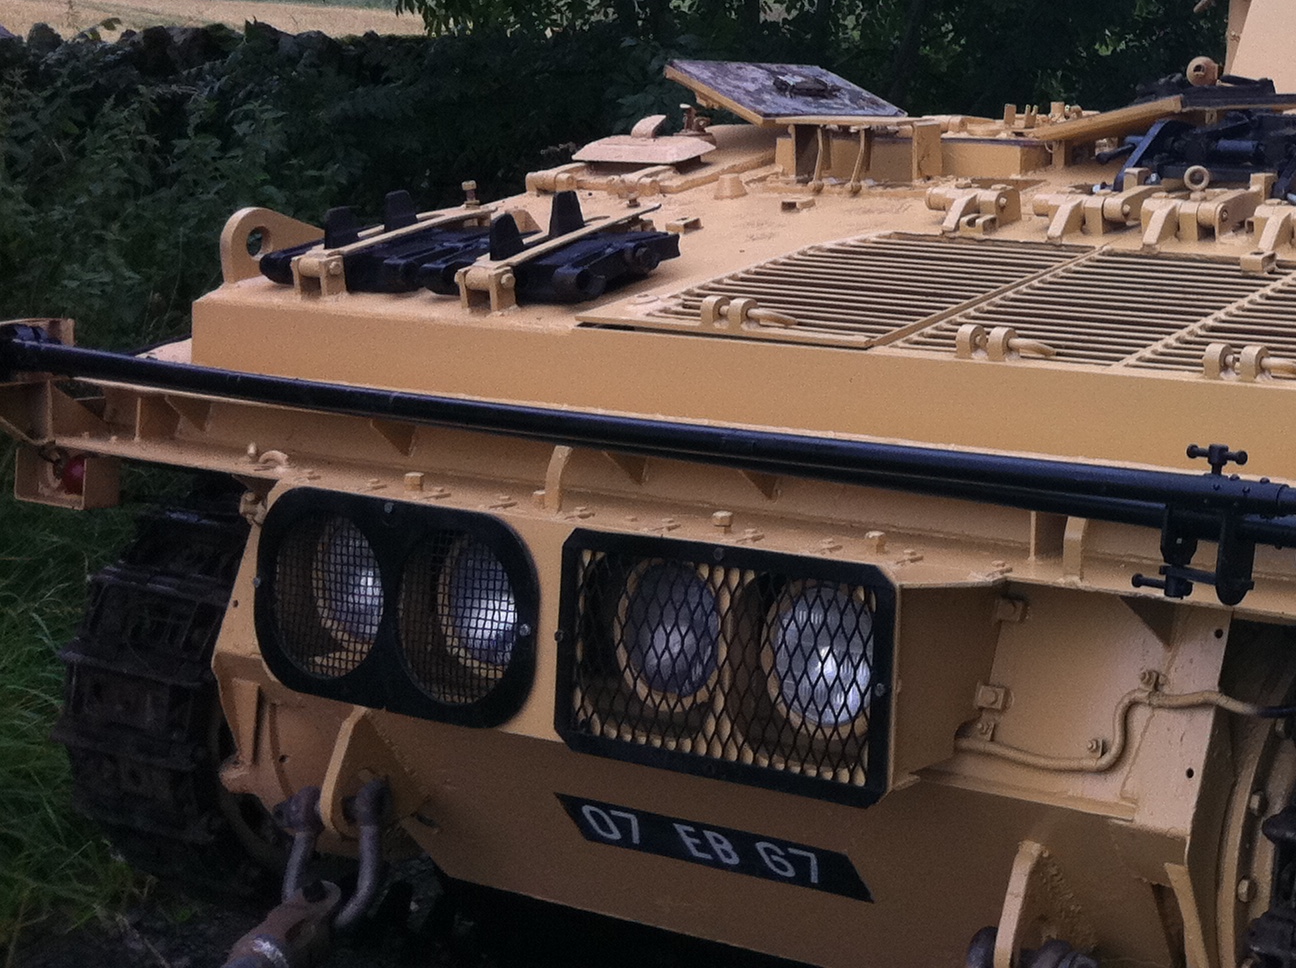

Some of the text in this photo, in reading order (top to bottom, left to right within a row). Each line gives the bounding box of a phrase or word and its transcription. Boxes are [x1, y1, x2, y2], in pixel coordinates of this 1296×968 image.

[582, 805, 819, 884] 07 EB 67
